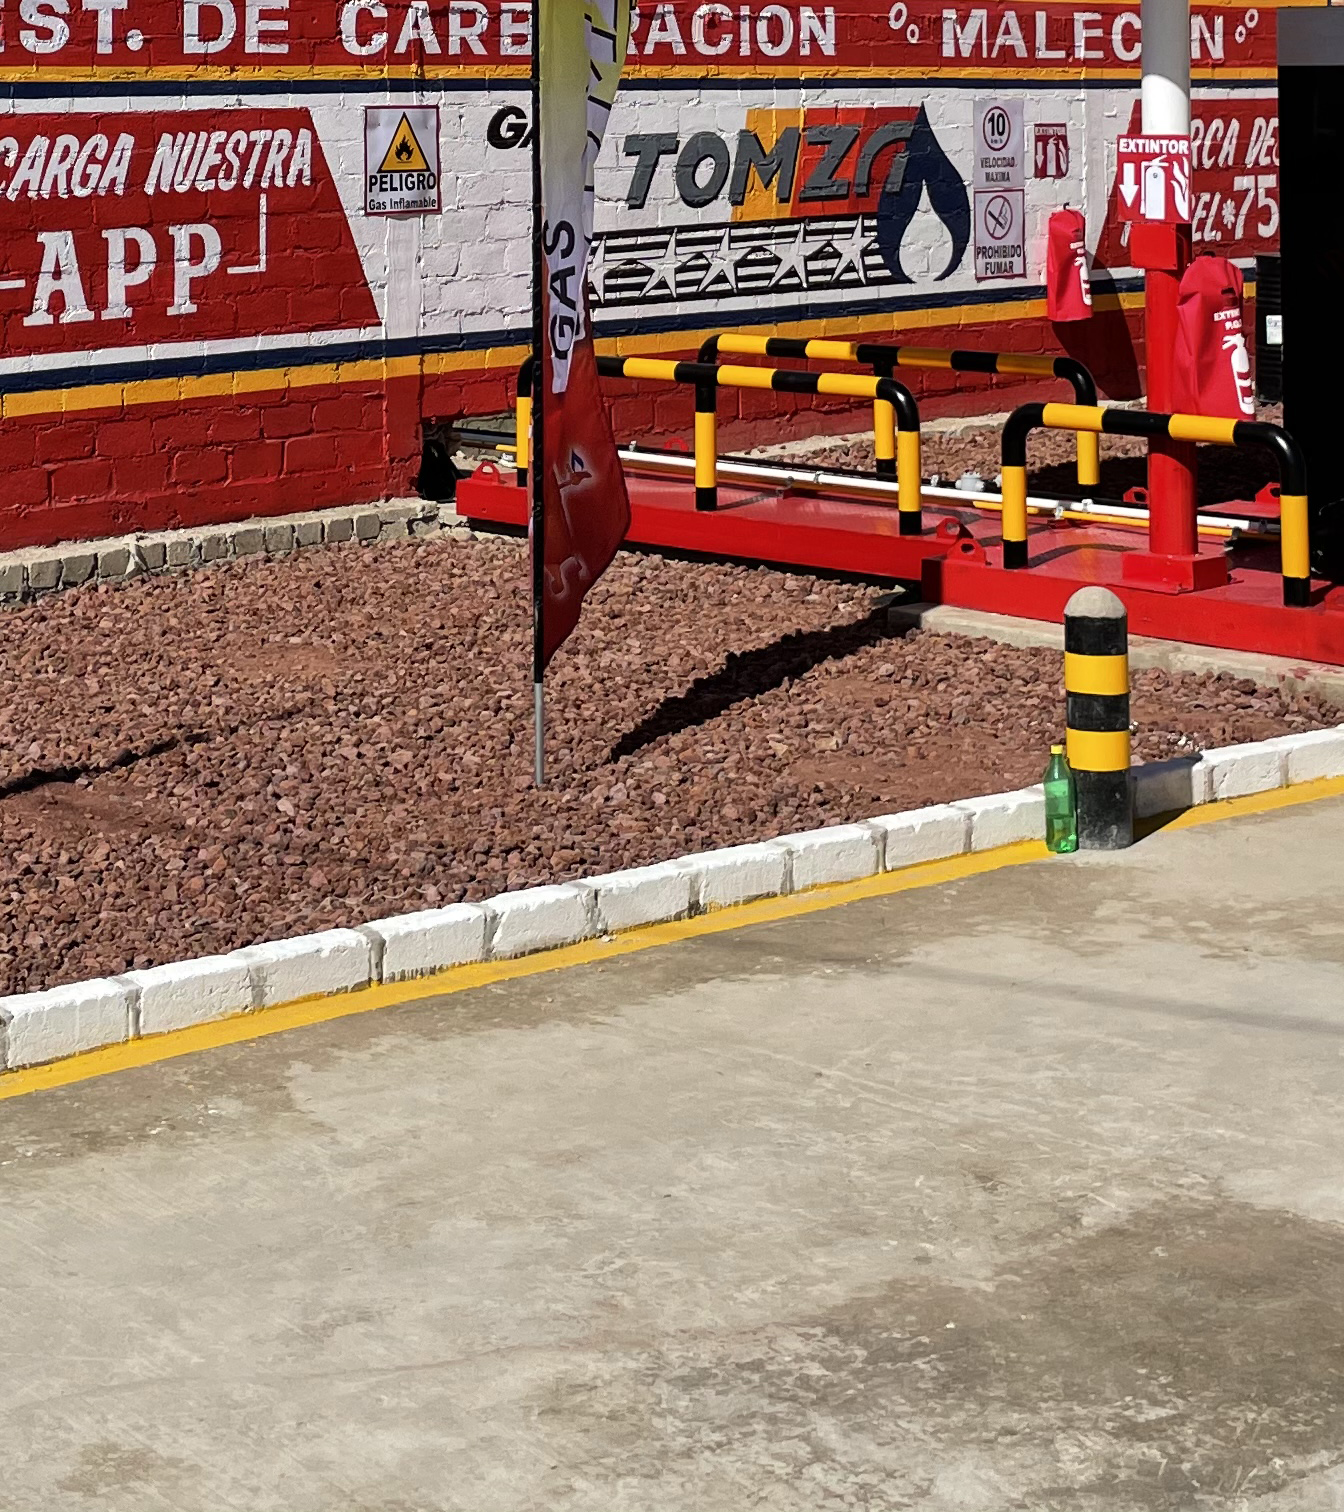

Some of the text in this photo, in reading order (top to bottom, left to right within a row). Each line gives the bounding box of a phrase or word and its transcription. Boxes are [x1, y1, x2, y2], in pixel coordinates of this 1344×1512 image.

[942, 8, 1224, 60] MALECN
[987, 112, 1006, 137] 10
[1119, 138, 1189, 154] EXTINTOR
[143, 127, 312, 197] NUESTRA
[368, 172, 436, 194] PELIGRO
[368, 196, 437, 211] Gas Inflamable
[976, 245, 1022, 260] PROHIBIDO
[23, 224, 223, 327] APP
[985, 261, 1014, 276] FUMAR
[542, 219, 580, 361] GAS
